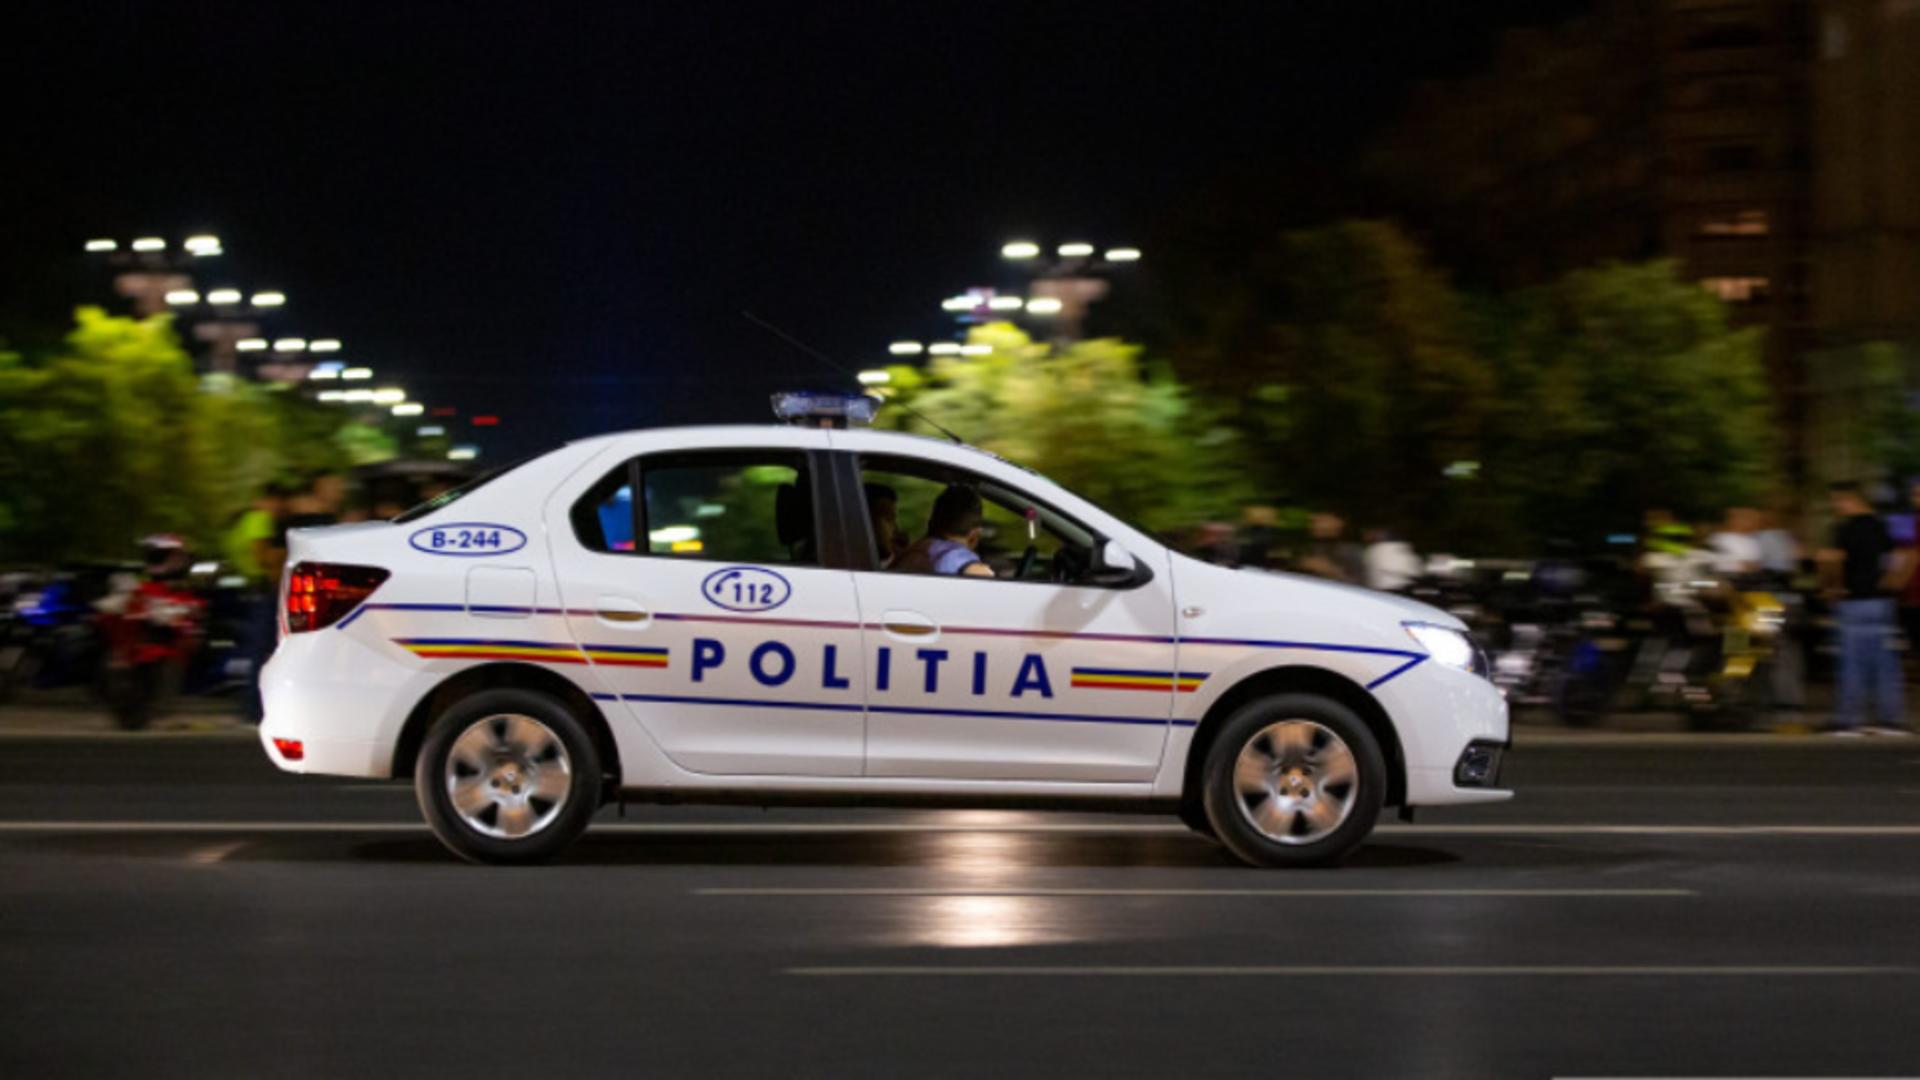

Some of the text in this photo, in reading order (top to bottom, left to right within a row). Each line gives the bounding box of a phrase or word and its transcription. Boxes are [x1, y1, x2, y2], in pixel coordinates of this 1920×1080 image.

[432, 530, 500, 548] B-244
[733, 583, 774, 604] 112
[690, 638, 1054, 698] POLITIA
